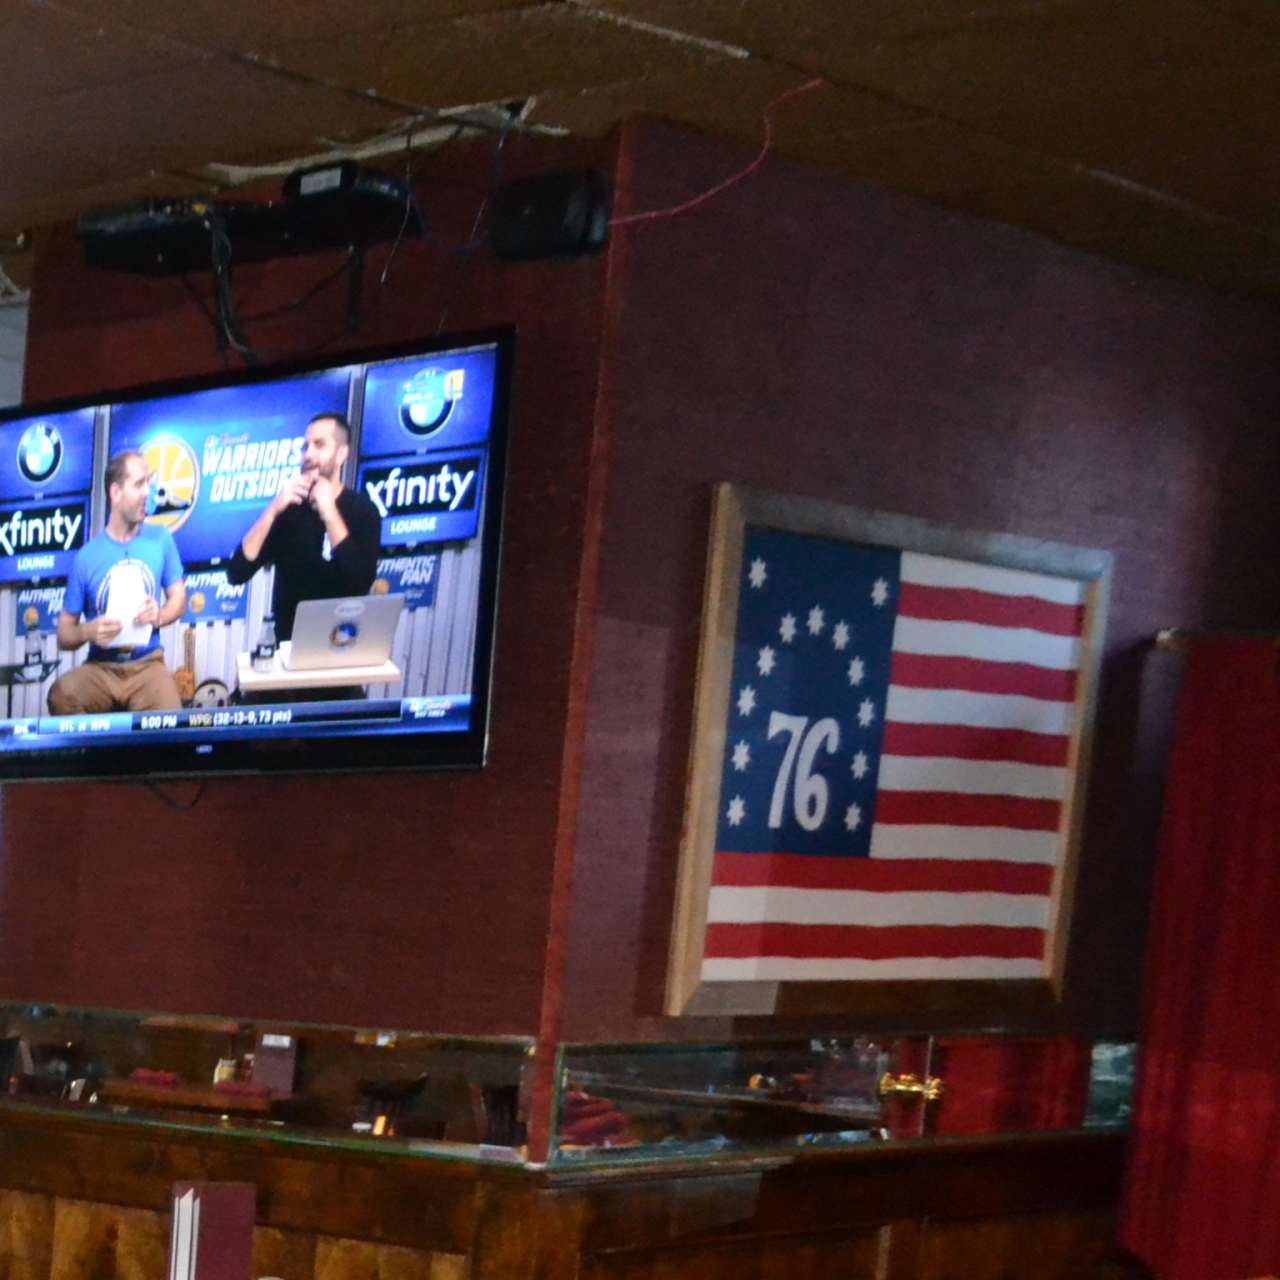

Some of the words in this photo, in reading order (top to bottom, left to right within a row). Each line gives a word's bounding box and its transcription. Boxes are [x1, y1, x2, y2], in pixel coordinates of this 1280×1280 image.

[203, 436, 305, 476] WARRIORS
[366, 463, 475, 518] xfinity
[390, 516, 437, 535] LOUNGE
[17, 555, 55, 571] LOUNGE
[376, 555, 436, 575] UTHENTIC
[18, 587, 66, 604] AUTHENT
[163, 714, 177, 727] PM
[767, 710, 840, 831] 76
